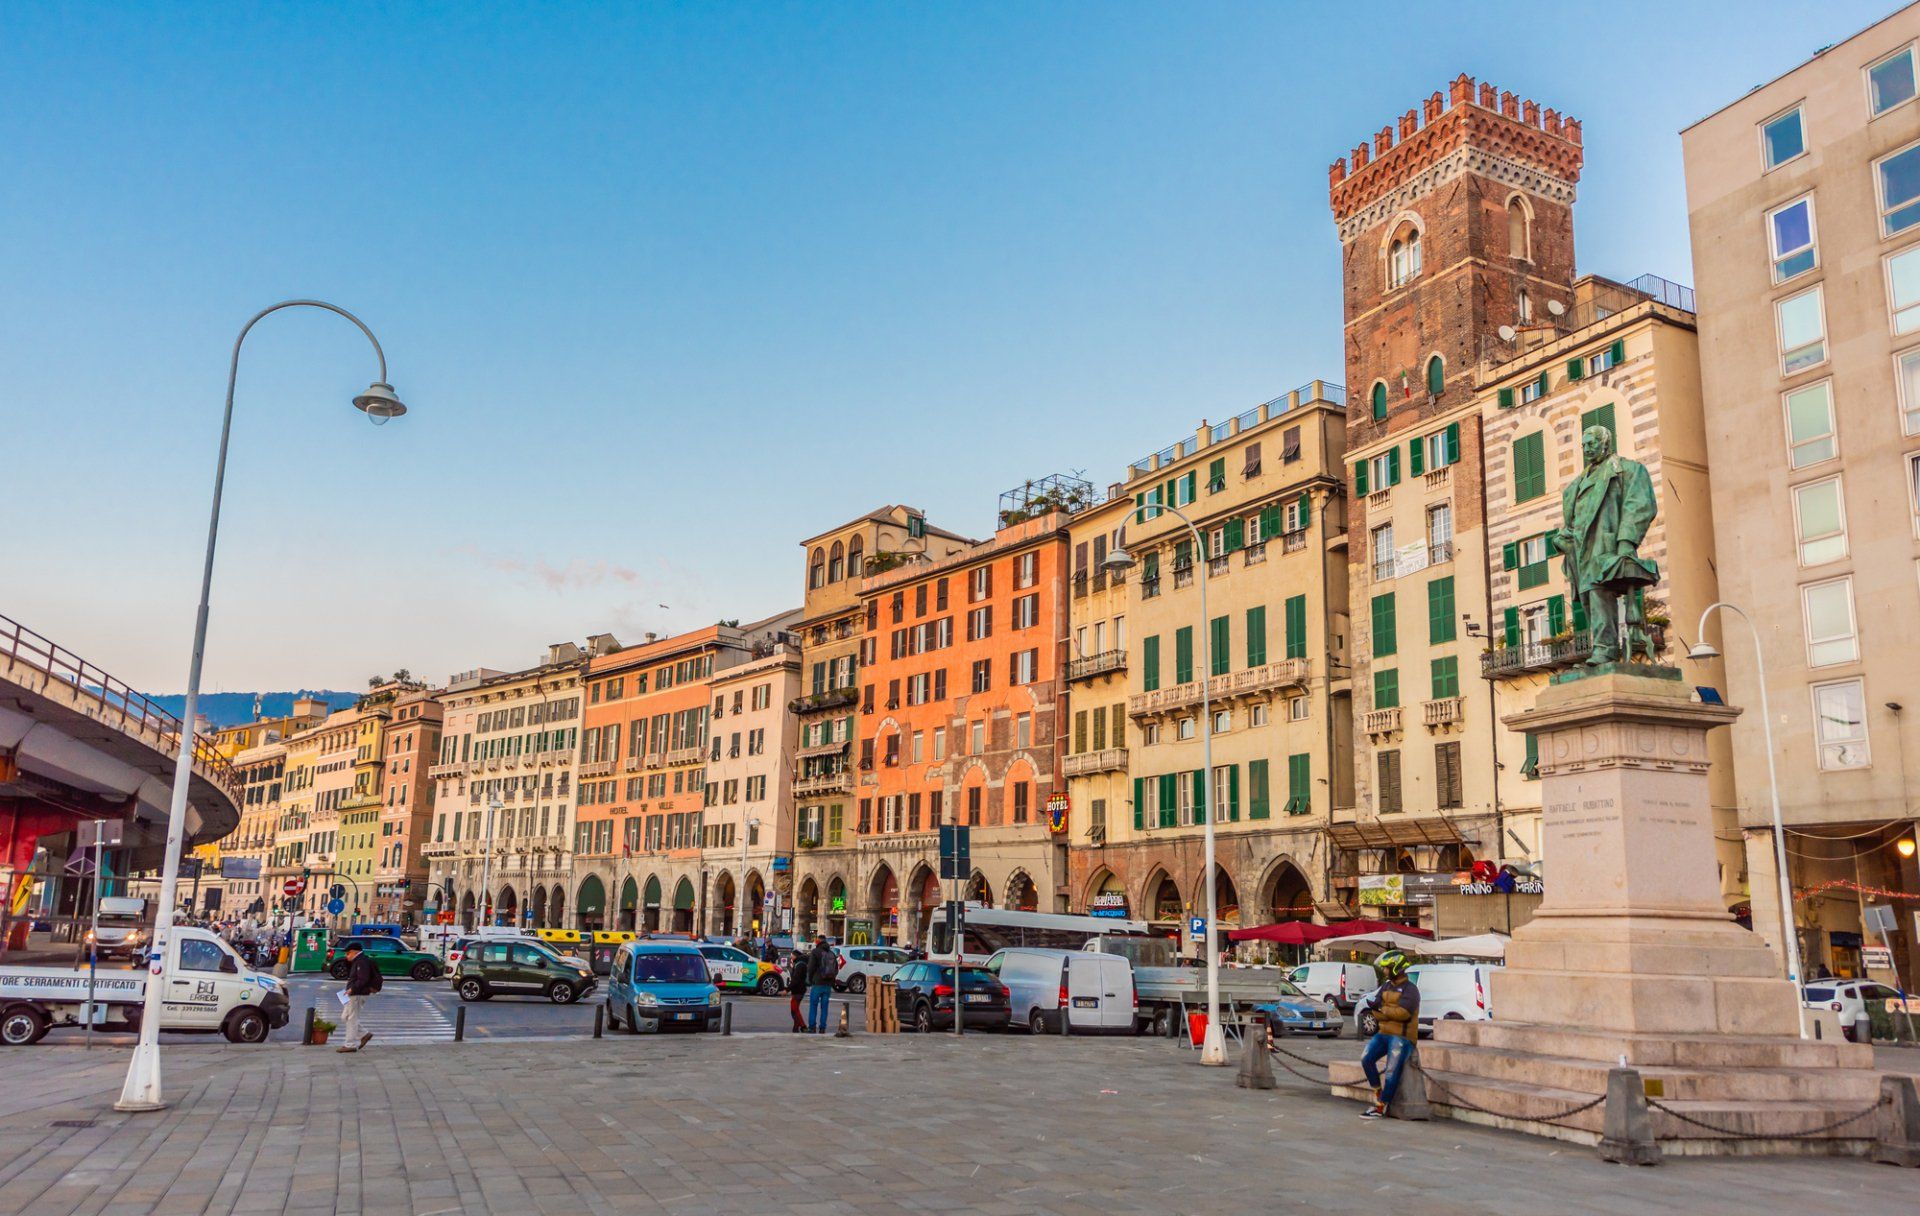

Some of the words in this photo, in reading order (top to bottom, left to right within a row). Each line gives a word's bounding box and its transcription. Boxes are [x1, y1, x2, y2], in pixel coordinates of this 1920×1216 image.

[610, 806, 628, 814] HOTEL
[1047, 800, 1068, 811] HOTEL
[1193, 919, 1203, 931] P
[0, 976, 20, 986] ORE
[23, 977, 80, 988] SERRAMENTI
[82, 978, 137, 990] CRTIFICATO
[189, 993, 219, 1002] ERREGI
